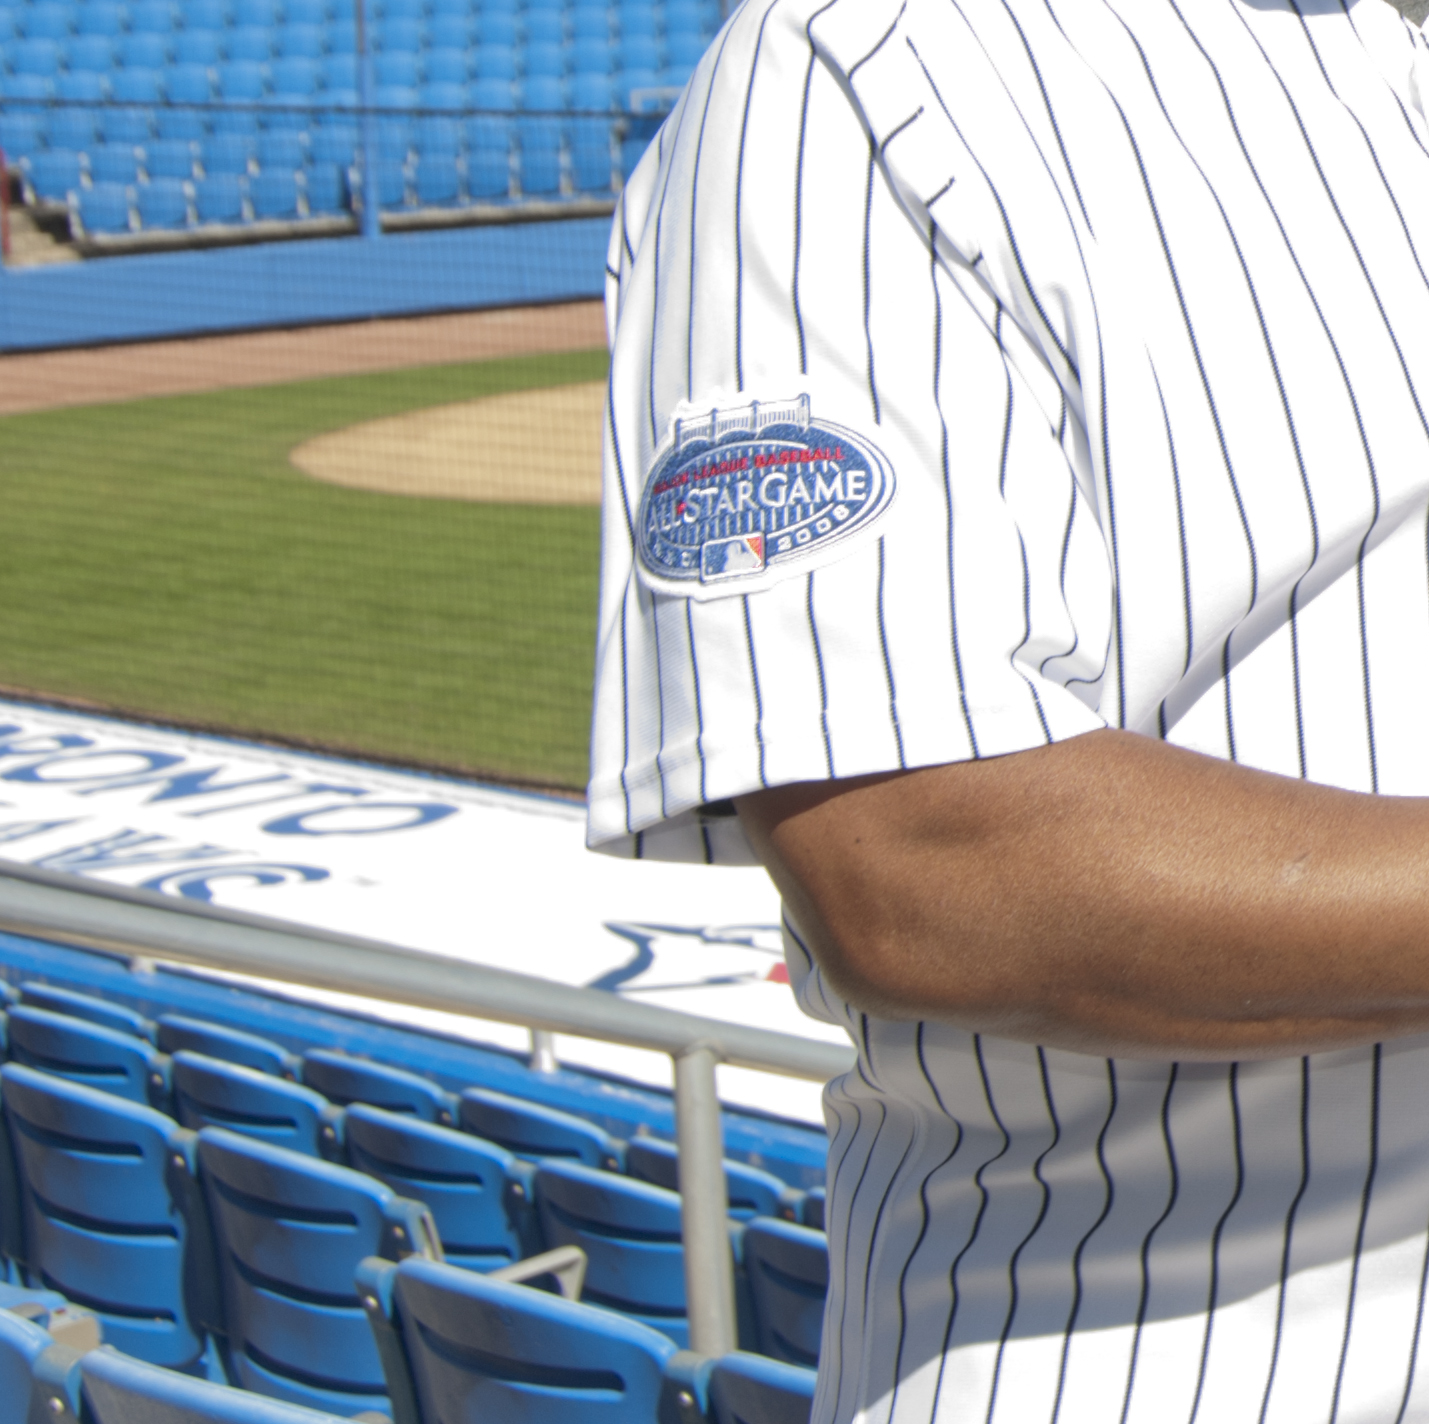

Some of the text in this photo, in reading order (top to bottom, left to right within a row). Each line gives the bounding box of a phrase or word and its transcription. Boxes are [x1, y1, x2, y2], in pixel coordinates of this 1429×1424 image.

[753, 445, 846, 469] BASEBALL
[682, 479, 759, 524] STAR
[757, 469, 868, 508] GAME
[776, 504, 851, 552] 2008
